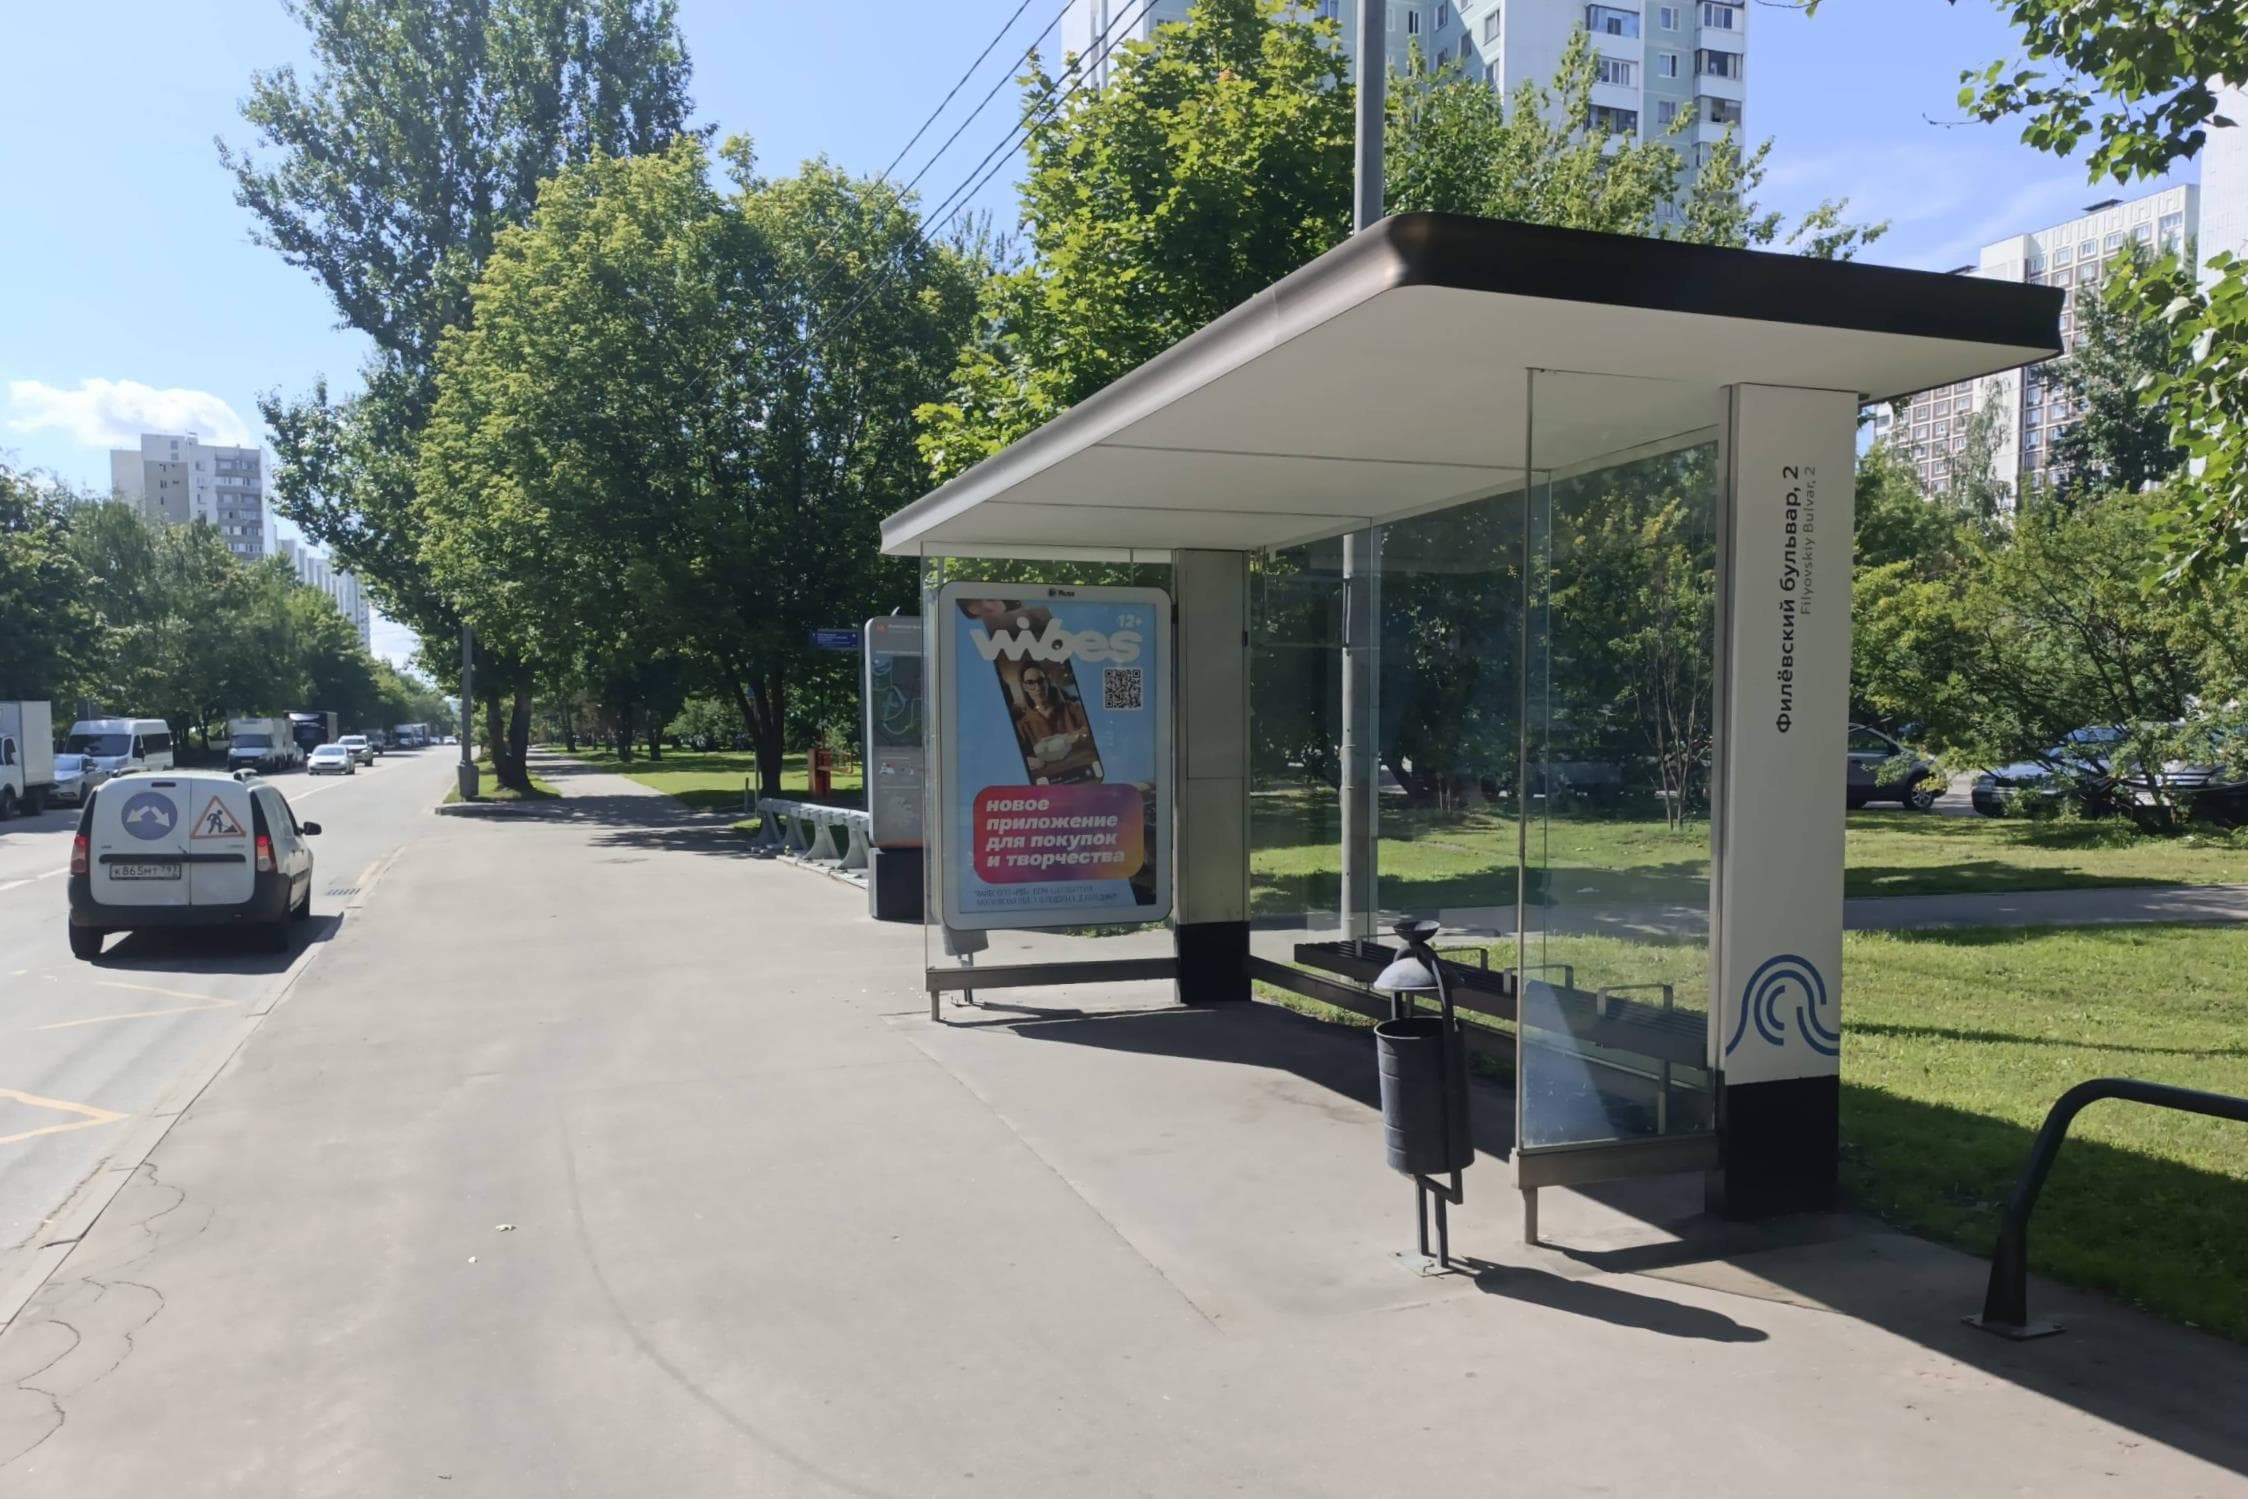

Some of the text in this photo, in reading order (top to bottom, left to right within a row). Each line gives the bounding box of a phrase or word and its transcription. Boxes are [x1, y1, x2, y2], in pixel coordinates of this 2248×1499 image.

[1801, 466, 1816, 615] Filyovskiy Bulvar, 2
[1776, 465, 1801, 733] Филёвский бульвар, 2
[1118, 614, 1143, 628] 12+
[986, 815, 1119, 834] приложение
[986, 832, 1118, 851] для покупок
[986, 850, 1125, 870] и творчества
